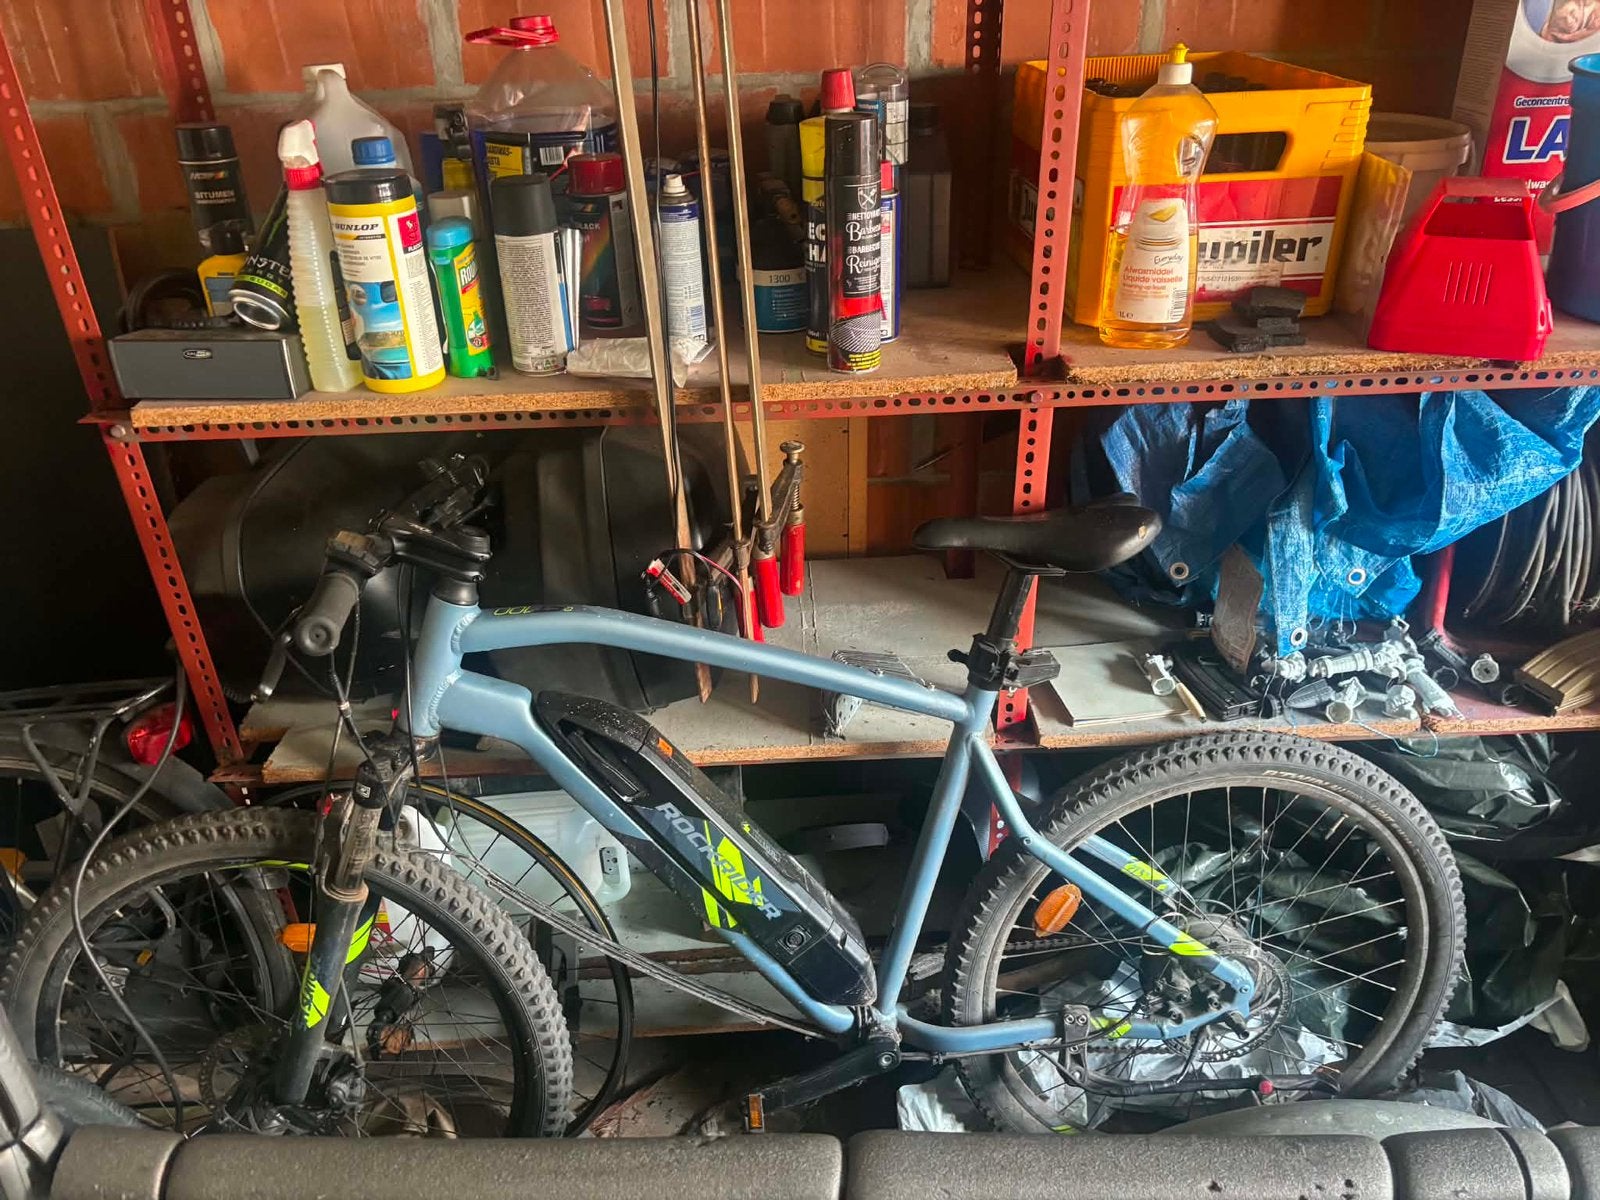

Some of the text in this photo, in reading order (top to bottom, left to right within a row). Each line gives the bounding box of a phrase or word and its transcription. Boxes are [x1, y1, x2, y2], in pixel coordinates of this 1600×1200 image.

[194, 189, 235, 199] BITUMEN
[334, 223, 379, 231] DUNLOP
[769, 274, 791, 283] 1300
[1123, 273, 1150, 284] Liquide
[656, 802, 783, 921] ROCKRIDER
